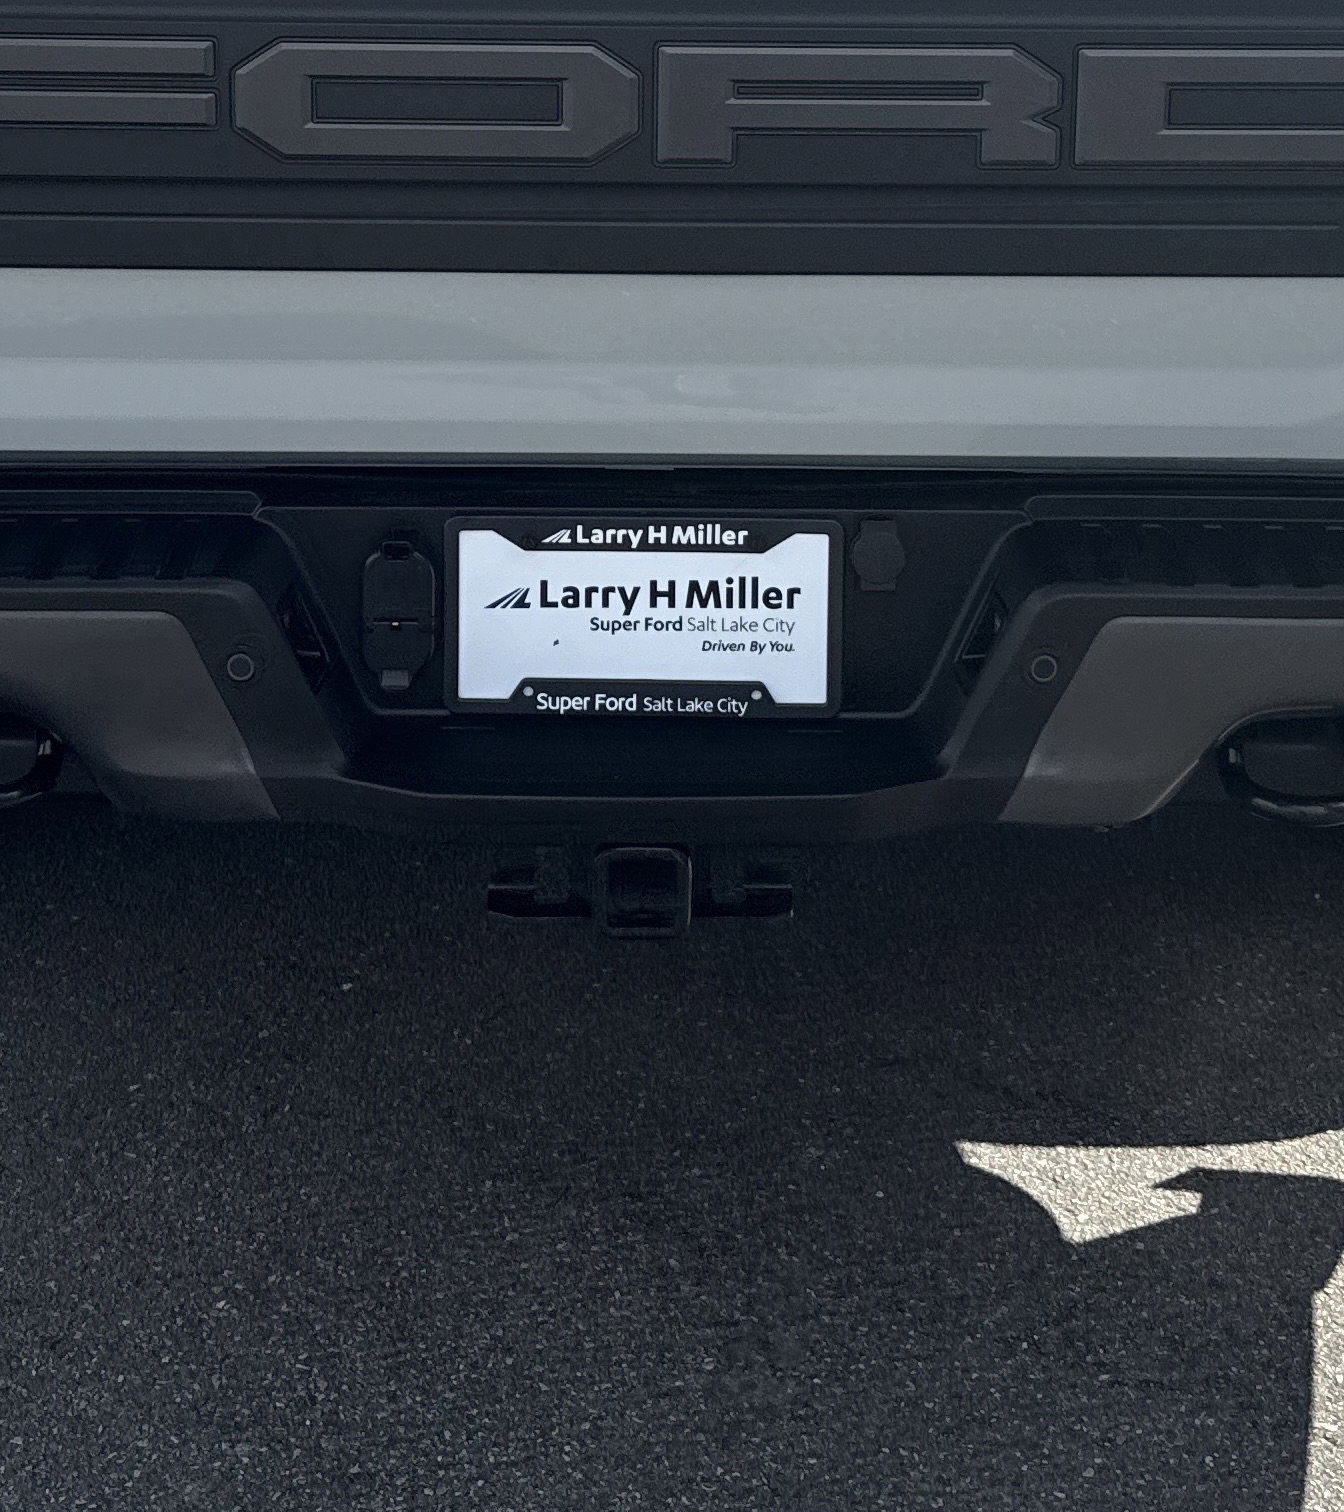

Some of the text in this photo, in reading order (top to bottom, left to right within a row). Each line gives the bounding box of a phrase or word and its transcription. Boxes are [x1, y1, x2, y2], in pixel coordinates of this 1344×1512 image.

[576, 523, 748, 548] Larry H Miller
[539, 576, 801, 615] Larry H Miller
[589, 616, 796, 636] Super Ford Salt Lake City
[701, 638, 796, 656] Driven By You.
[536, 692, 749, 717] Super Ford Salt Lake City
